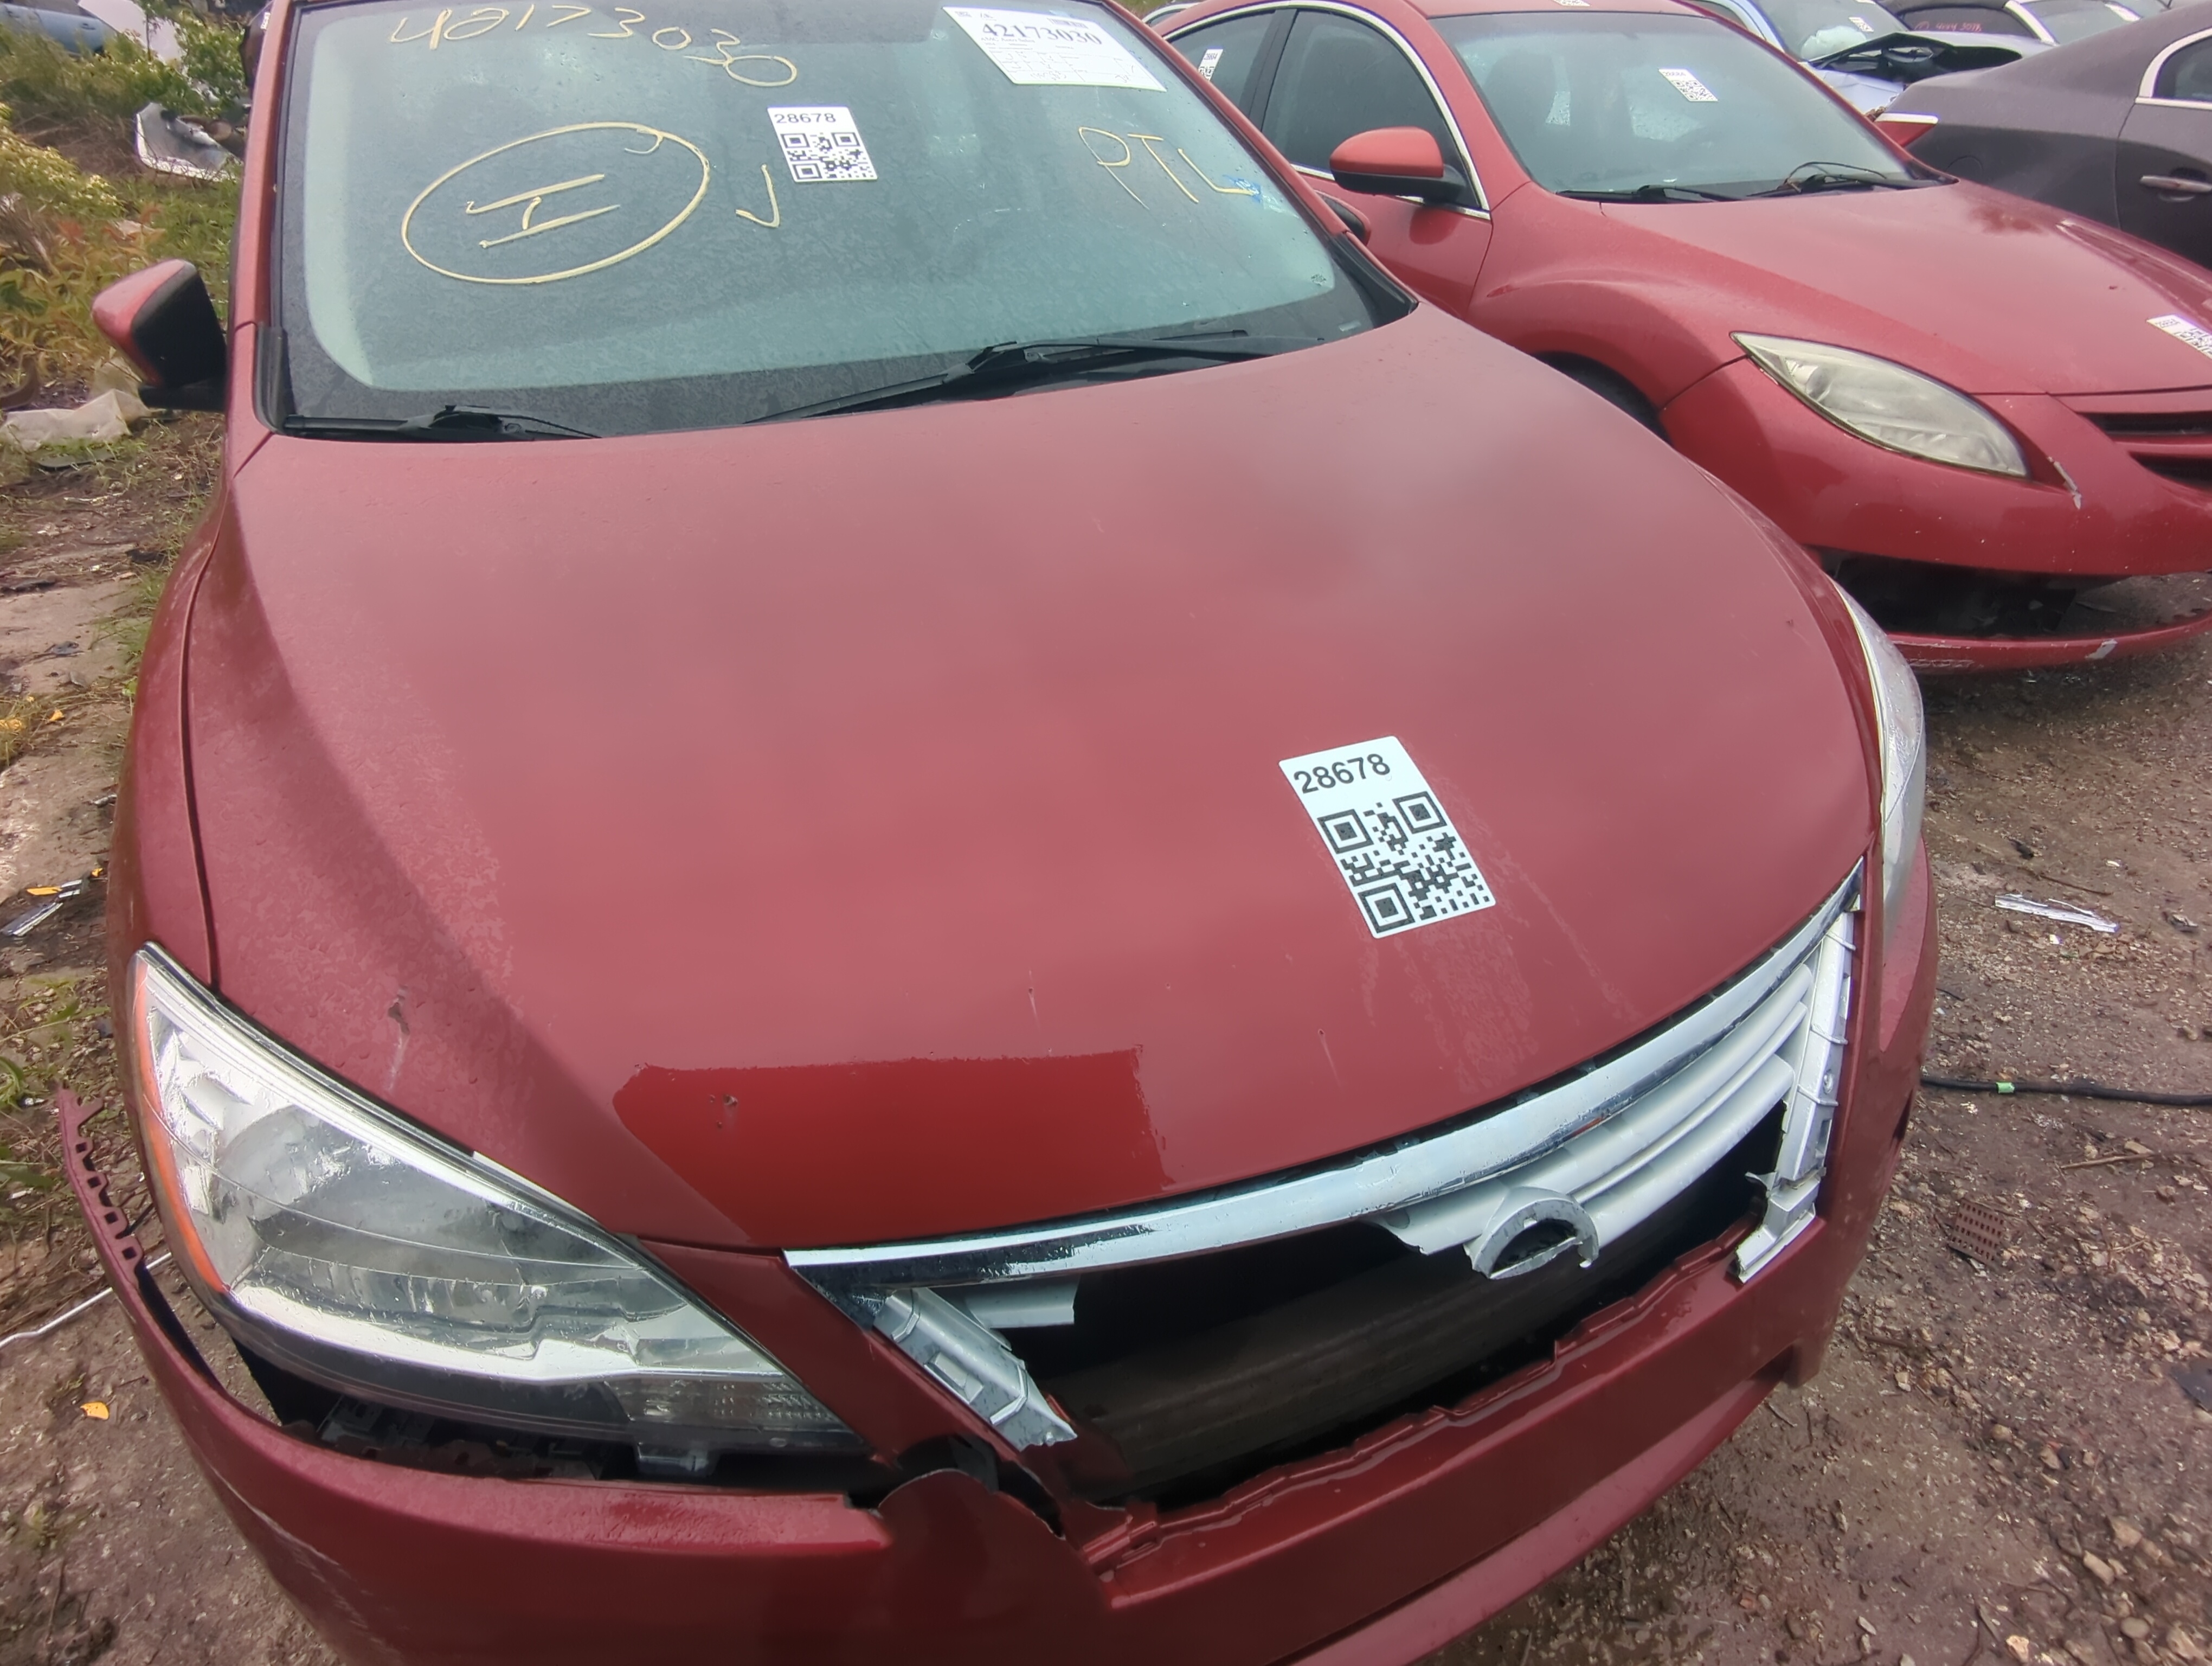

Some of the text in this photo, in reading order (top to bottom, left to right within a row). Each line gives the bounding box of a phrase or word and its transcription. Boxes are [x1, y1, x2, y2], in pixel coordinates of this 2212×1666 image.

[982, 23, 1102, 45] 42173030
[774, 113, 837, 124] 28678
[1294, 753, 1391, 793] 28678
